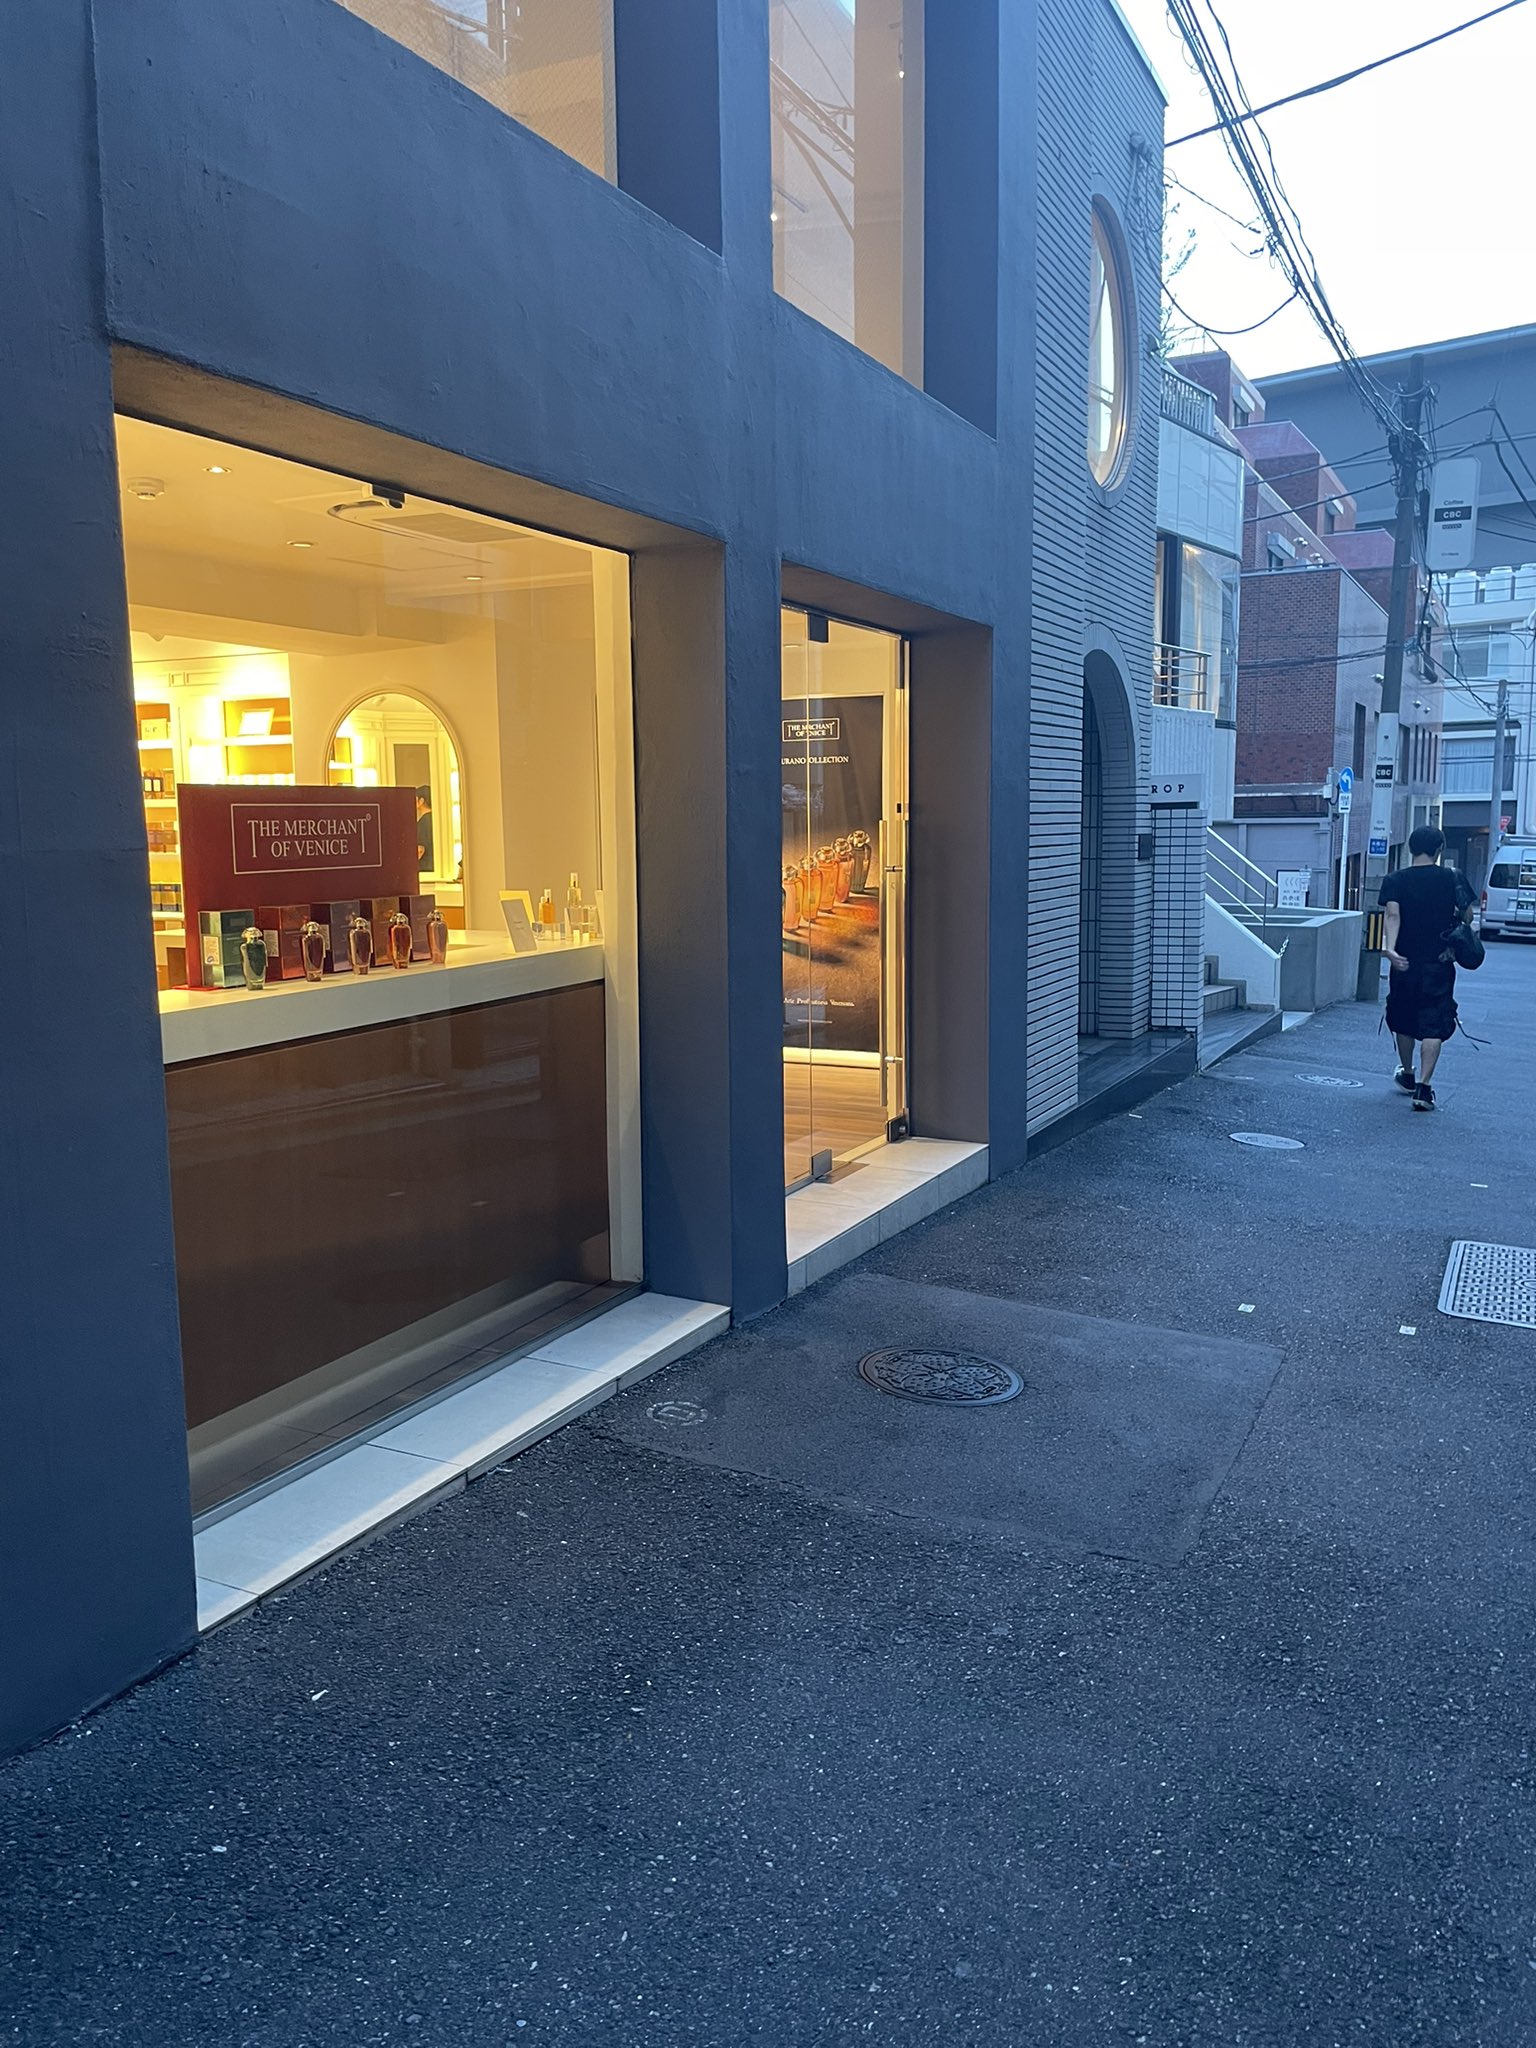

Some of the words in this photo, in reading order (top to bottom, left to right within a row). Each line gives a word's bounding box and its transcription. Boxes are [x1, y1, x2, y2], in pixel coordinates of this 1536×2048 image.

[787, 724, 800, 737] THE
[802, 722, 834, 735] MRCHANT
[808, 756, 849, 764] OLLECTION
[248, 820, 281, 858] THE
[284, 818, 367, 853] MERCHANT
[271, 841, 291, 858] OF
[294, 839, 349, 856] VENICE
